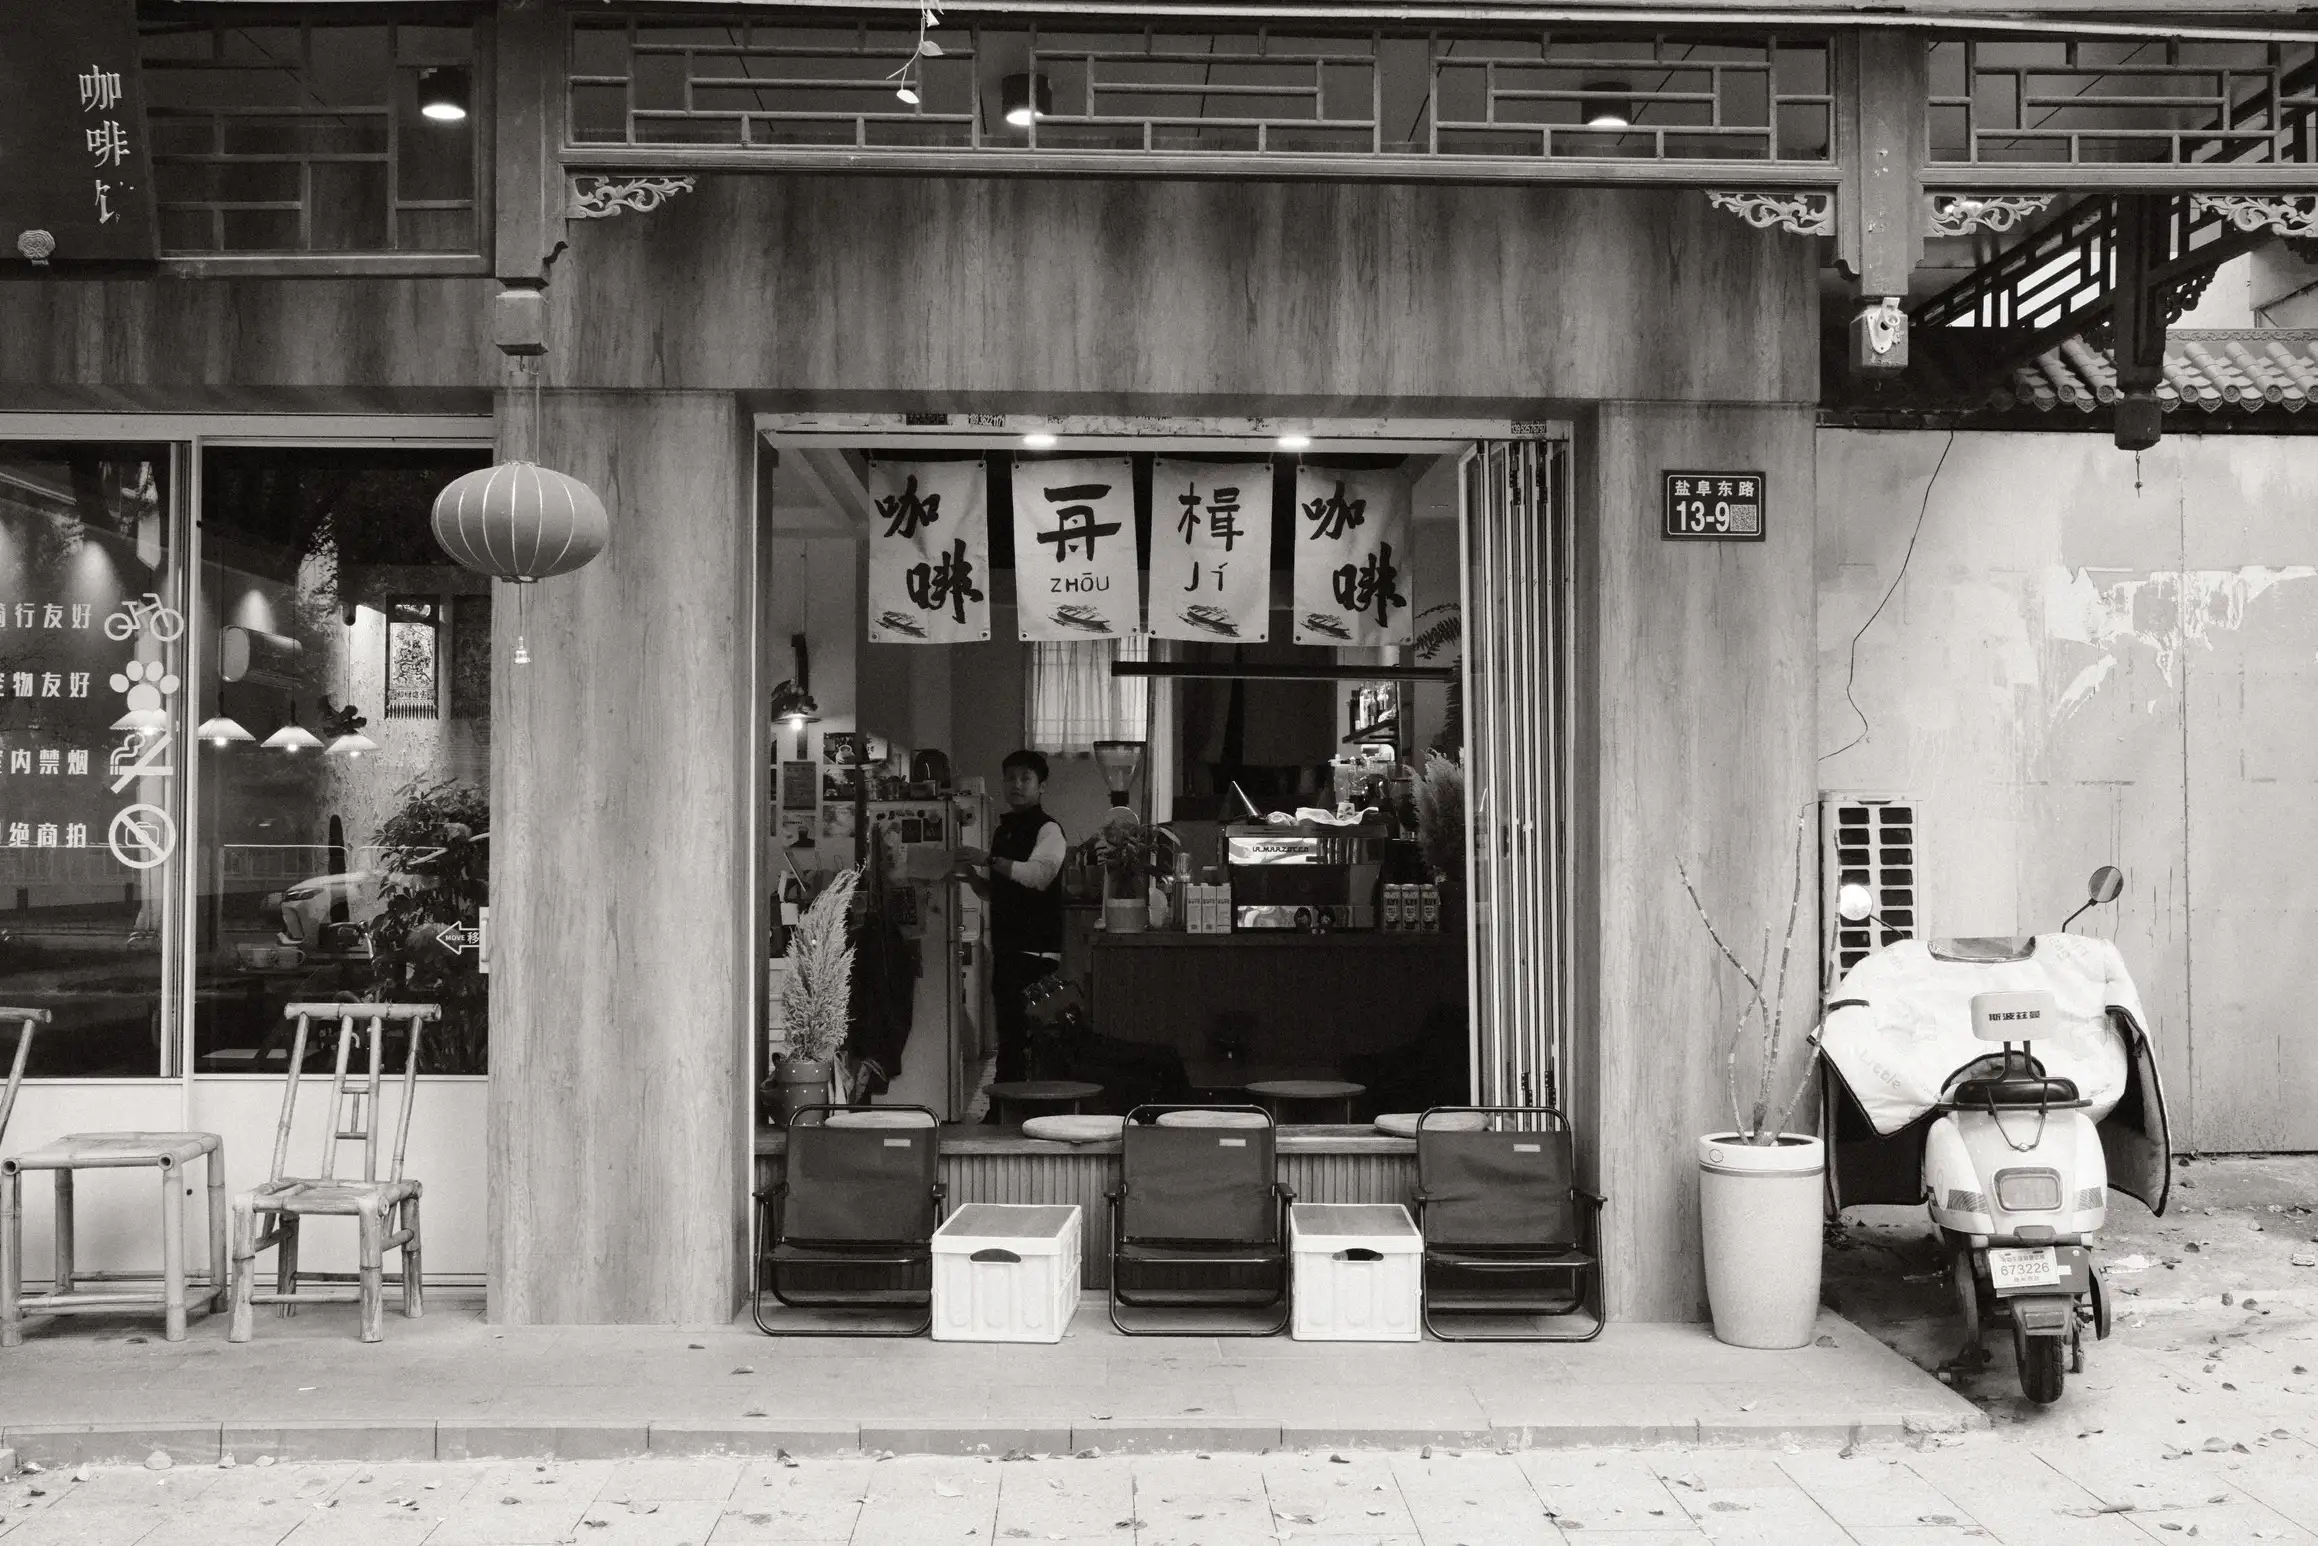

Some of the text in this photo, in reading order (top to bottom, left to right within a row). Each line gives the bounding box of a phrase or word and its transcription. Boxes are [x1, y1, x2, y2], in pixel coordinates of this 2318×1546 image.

[1674, 480, 1755, 497] 盐阜东路
[1178, 481, 1244, 552] 楫
[1676, 501, 1730, 532] 13-9
[874, 474, 984, 624] 咖啡
[1302, 480, 1407, 628] 咖啡
[1050, 572, 1110, 593] ZHŌU
[0, 672, 90, 698] 物友好
[0, 749, 89, 775] 内禁烟
[0, 822, 87, 848] 绝商拍
[467, 931, 480, 944] 移
[2000, 1262, 2050, 1276] 673226
